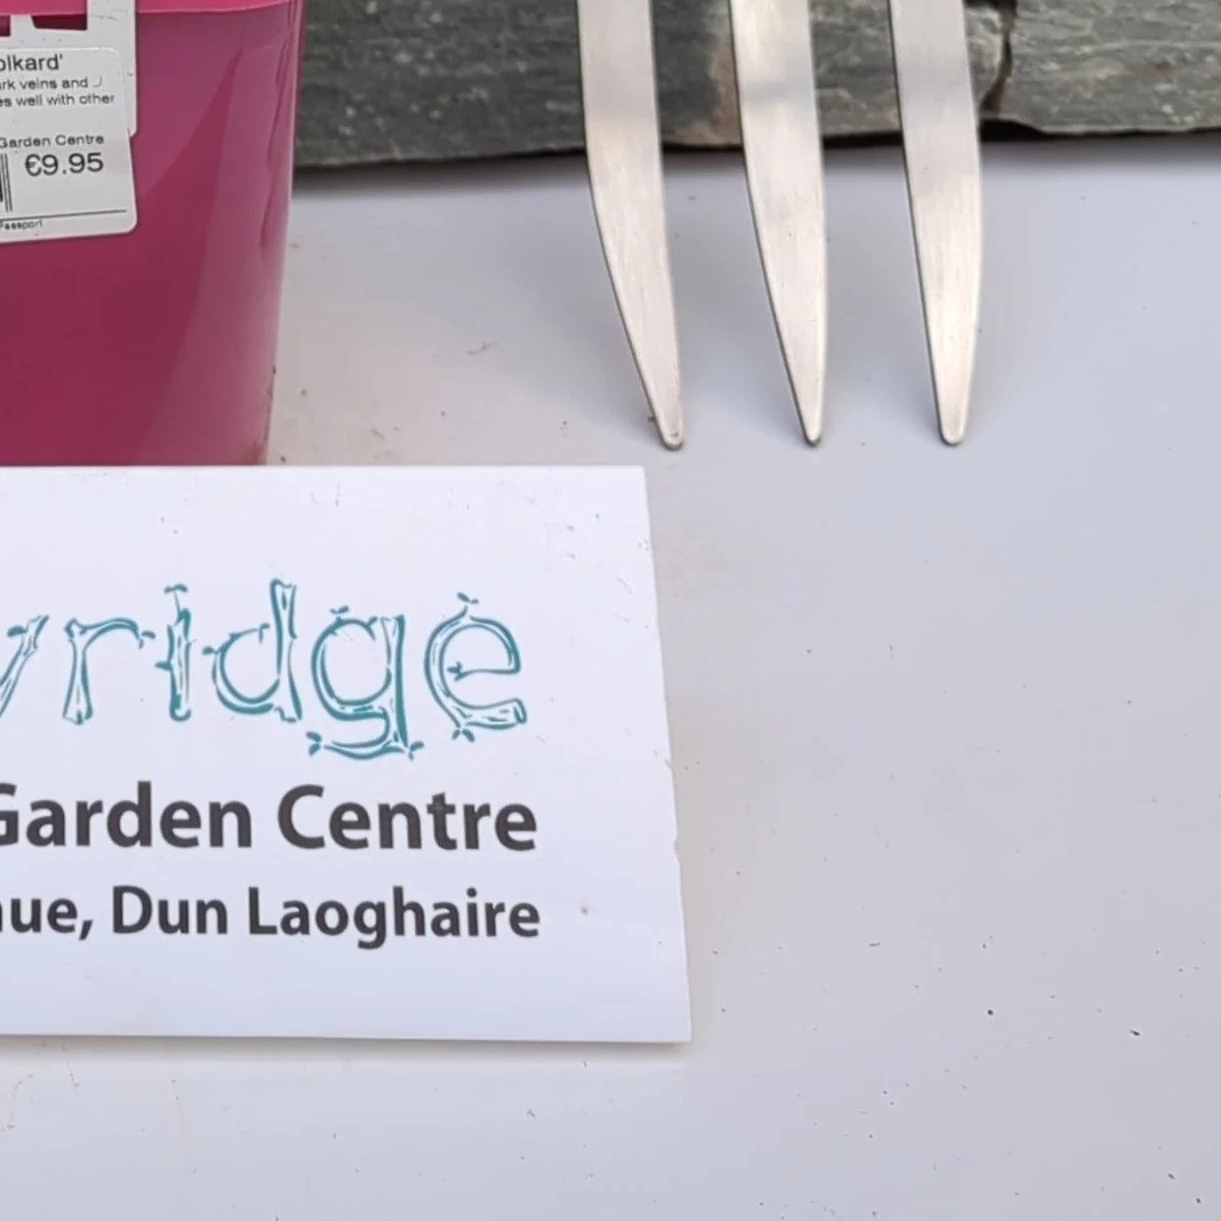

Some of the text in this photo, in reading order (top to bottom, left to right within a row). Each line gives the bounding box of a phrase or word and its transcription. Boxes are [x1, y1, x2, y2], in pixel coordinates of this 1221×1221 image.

[20, 79, 58, 90] veins
[63, 77, 88, 89] and
[16, 94, 43, 107] well
[47, 94, 75, 106] with
[80, 93, 115, 105] other
[55, 134, 104, 146] Centre
[25, 152, 104, 176] €9.95
[277, 784, 538, 852] Centre
[112, 884, 229, 936] Dun
[248, 885, 541, 950] Laoghaire
